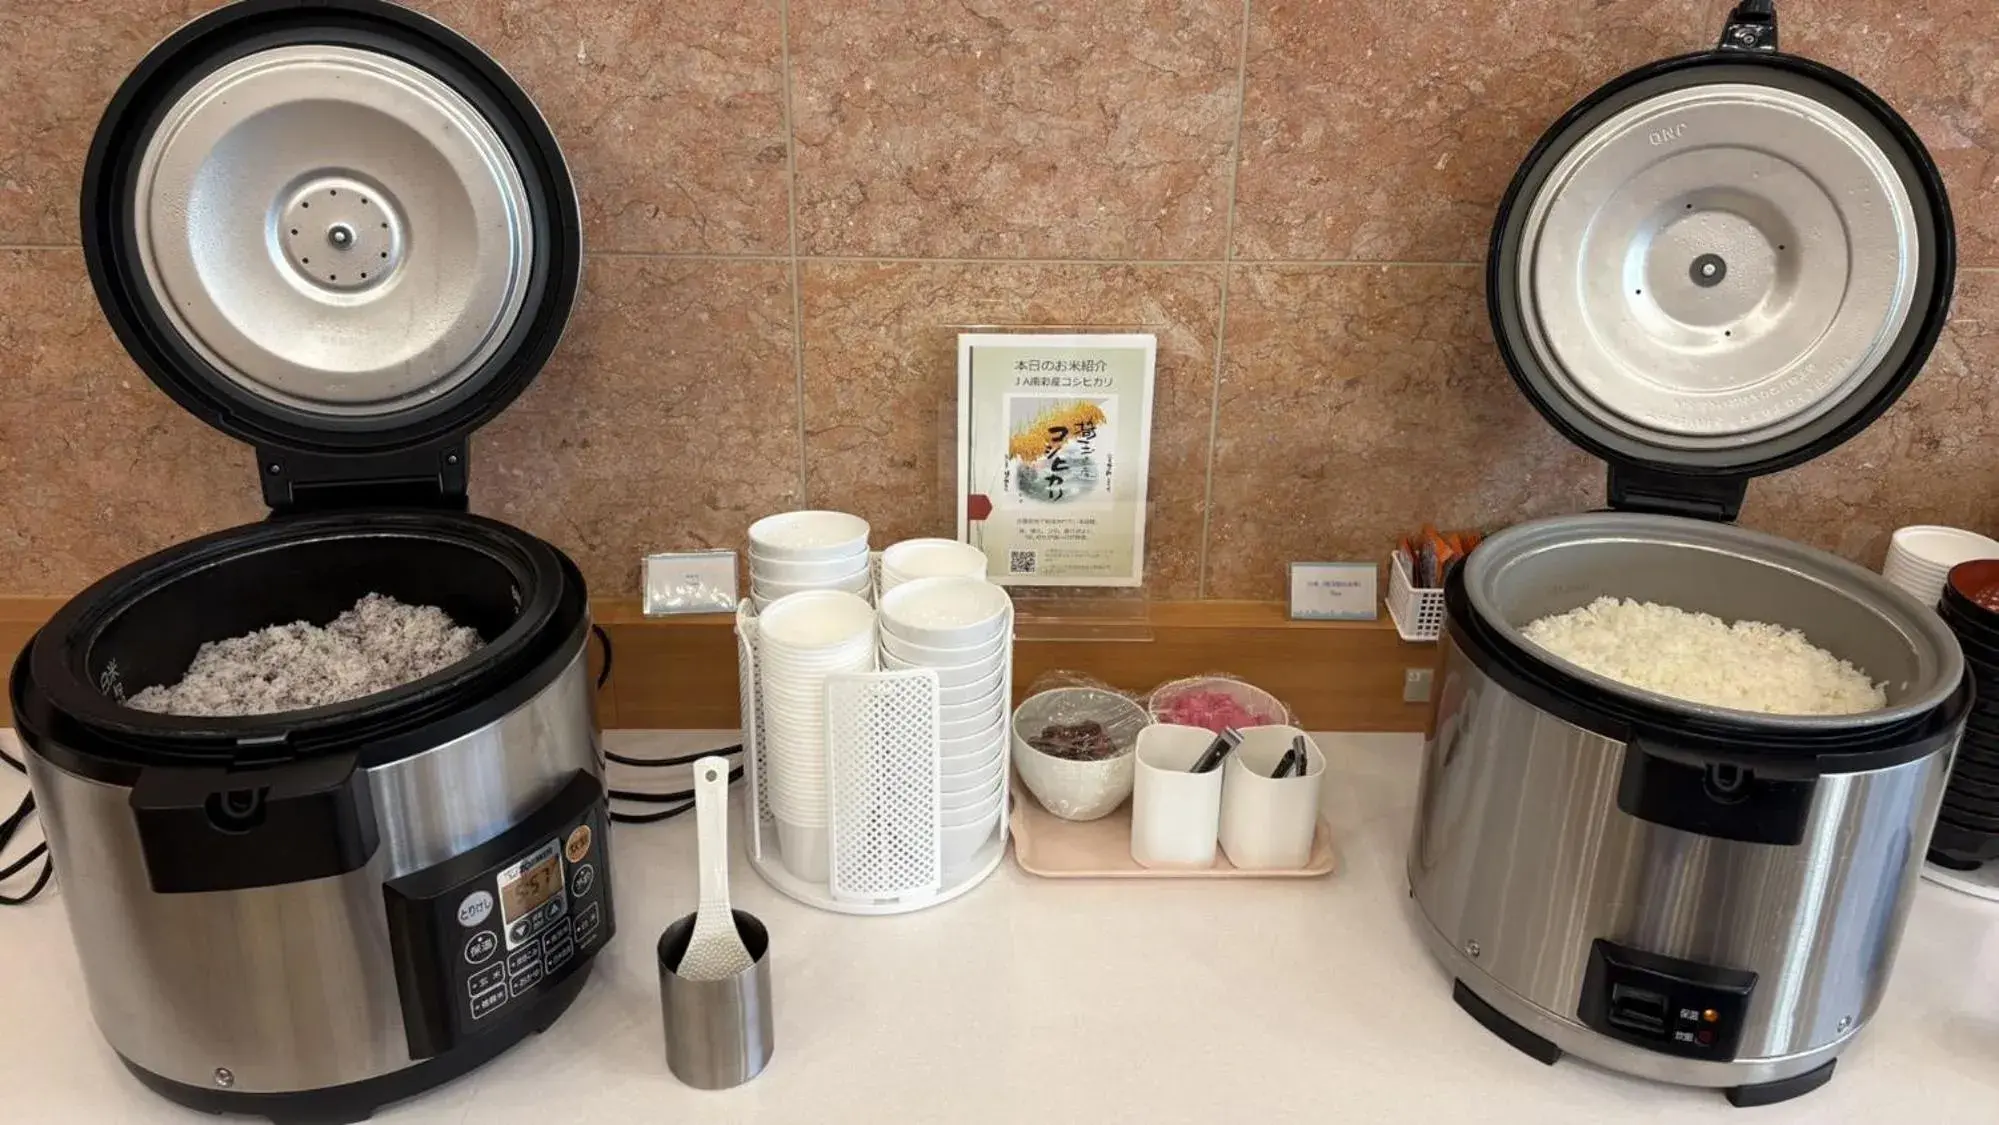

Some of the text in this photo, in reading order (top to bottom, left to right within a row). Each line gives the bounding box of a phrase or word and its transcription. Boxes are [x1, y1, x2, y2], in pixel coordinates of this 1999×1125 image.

[1014, 359, 1108, 373] 本日のお米紹介
[1044, 426, 1070, 502] コシヒカリ
[460, 897, 491, 922] とりけし
[470, 940, 494, 958] 保温
